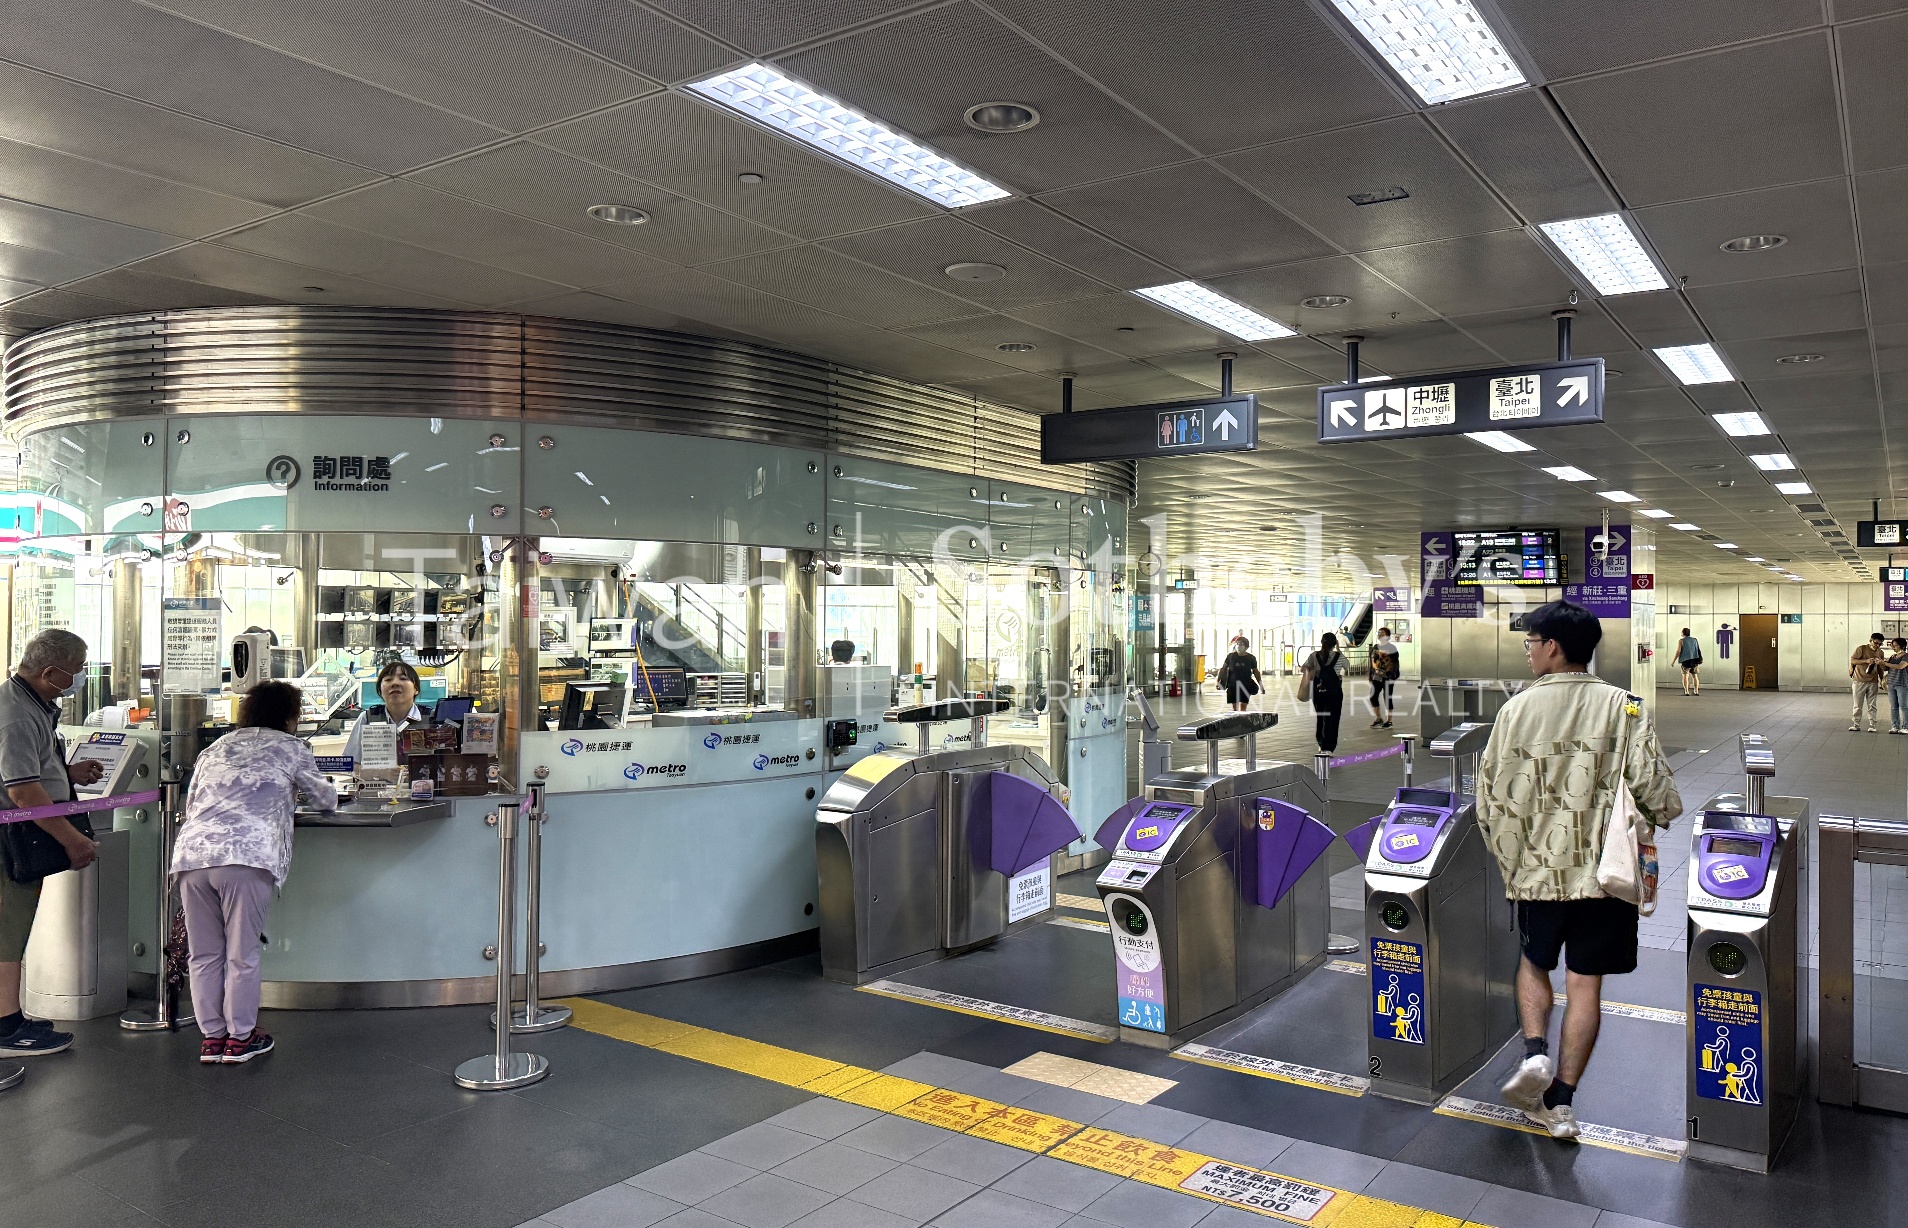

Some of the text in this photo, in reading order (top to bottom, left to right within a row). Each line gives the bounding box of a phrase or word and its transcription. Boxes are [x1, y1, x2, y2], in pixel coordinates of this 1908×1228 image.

[1413, 385, 1450, 405] 中壢
[1494, 377, 1535, 398] 臺北
[1411, 404, 1451, 415] Zhongli
[1499, 397, 1531, 408] Taipei
[313, 456, 391, 480] 詢問處
[314, 481, 389, 491] Information
[1876, 525, 1897, 534] 臺北
[1605, 556, 1625, 566] 臺北
[1566, 586, 1577, 595] 經
[585, 741, 633, 752] 桃園捷運
[722, 733, 760, 745] 桃園捷運
[770, 754, 800, 765] metro
[646, 763, 687, 775] metro
[1732, 870, 1746, 878] IC
[1119, 935, 1154, 950] 行動支付
[1376, 941, 1417, 954] 免票孩童與
[1373, 949, 1421, 964] 行李箱走前面
[1127, 984, 1155, 999] 好方便
[1702, 988, 1754, 1003] 免票孩童與
[1697, 996, 1759, 1014] 行李箱走前面
[1205, 1048, 1354, 1083] 請於線外 感應票卡
[1369, 1056, 1382, 1077] 2
[1446, 1104, 1469, 1112] Stay
[1581, 1131, 1625, 1145] ouching
[1687, 1116, 1700, 1140] 1
[912, 1100, 928, 1108] No
[931, 1105, 972, 1121] Eating
[974, 1116, 992, 1124] or
[991, 1120, 1054, 1142] Drinking
[1062, 1141, 1115, 1158] eyond
[1115, 1153, 1146, 1166] this
[1146, 1162, 1184, 1177] Line
[1201, 1170, 1321, 1205] MAXIMUM FINE
